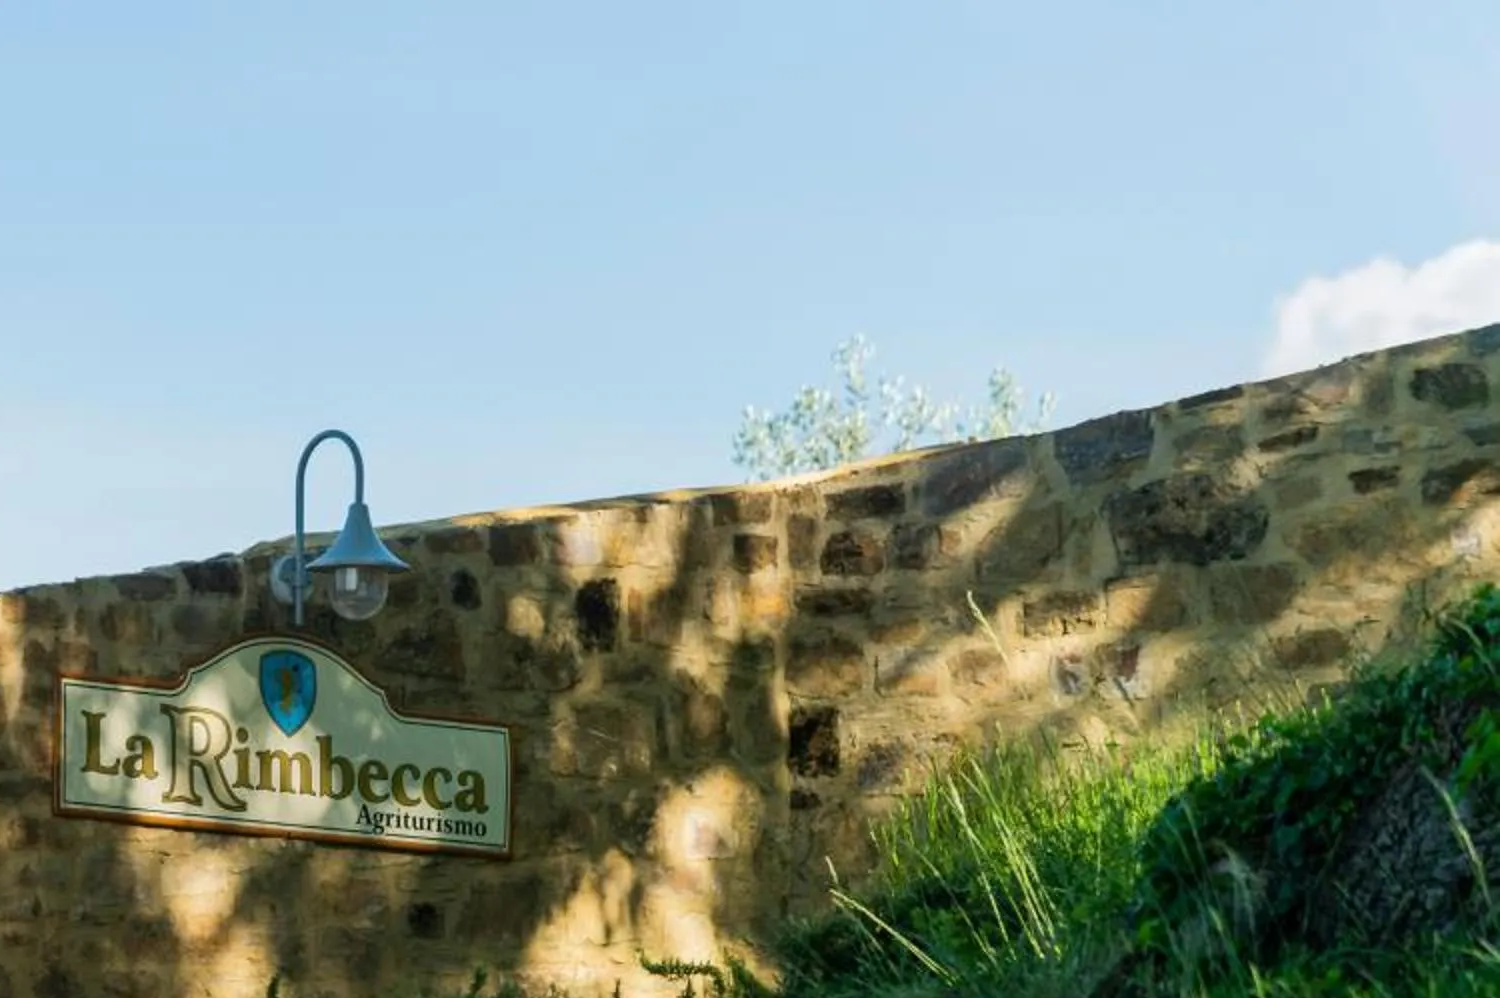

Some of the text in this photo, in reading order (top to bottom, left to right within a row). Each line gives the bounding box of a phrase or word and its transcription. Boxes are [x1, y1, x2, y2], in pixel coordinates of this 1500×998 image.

[82, 704, 488, 813] La Rimbecca
[356, 804, 487, 837] Agriturismo
